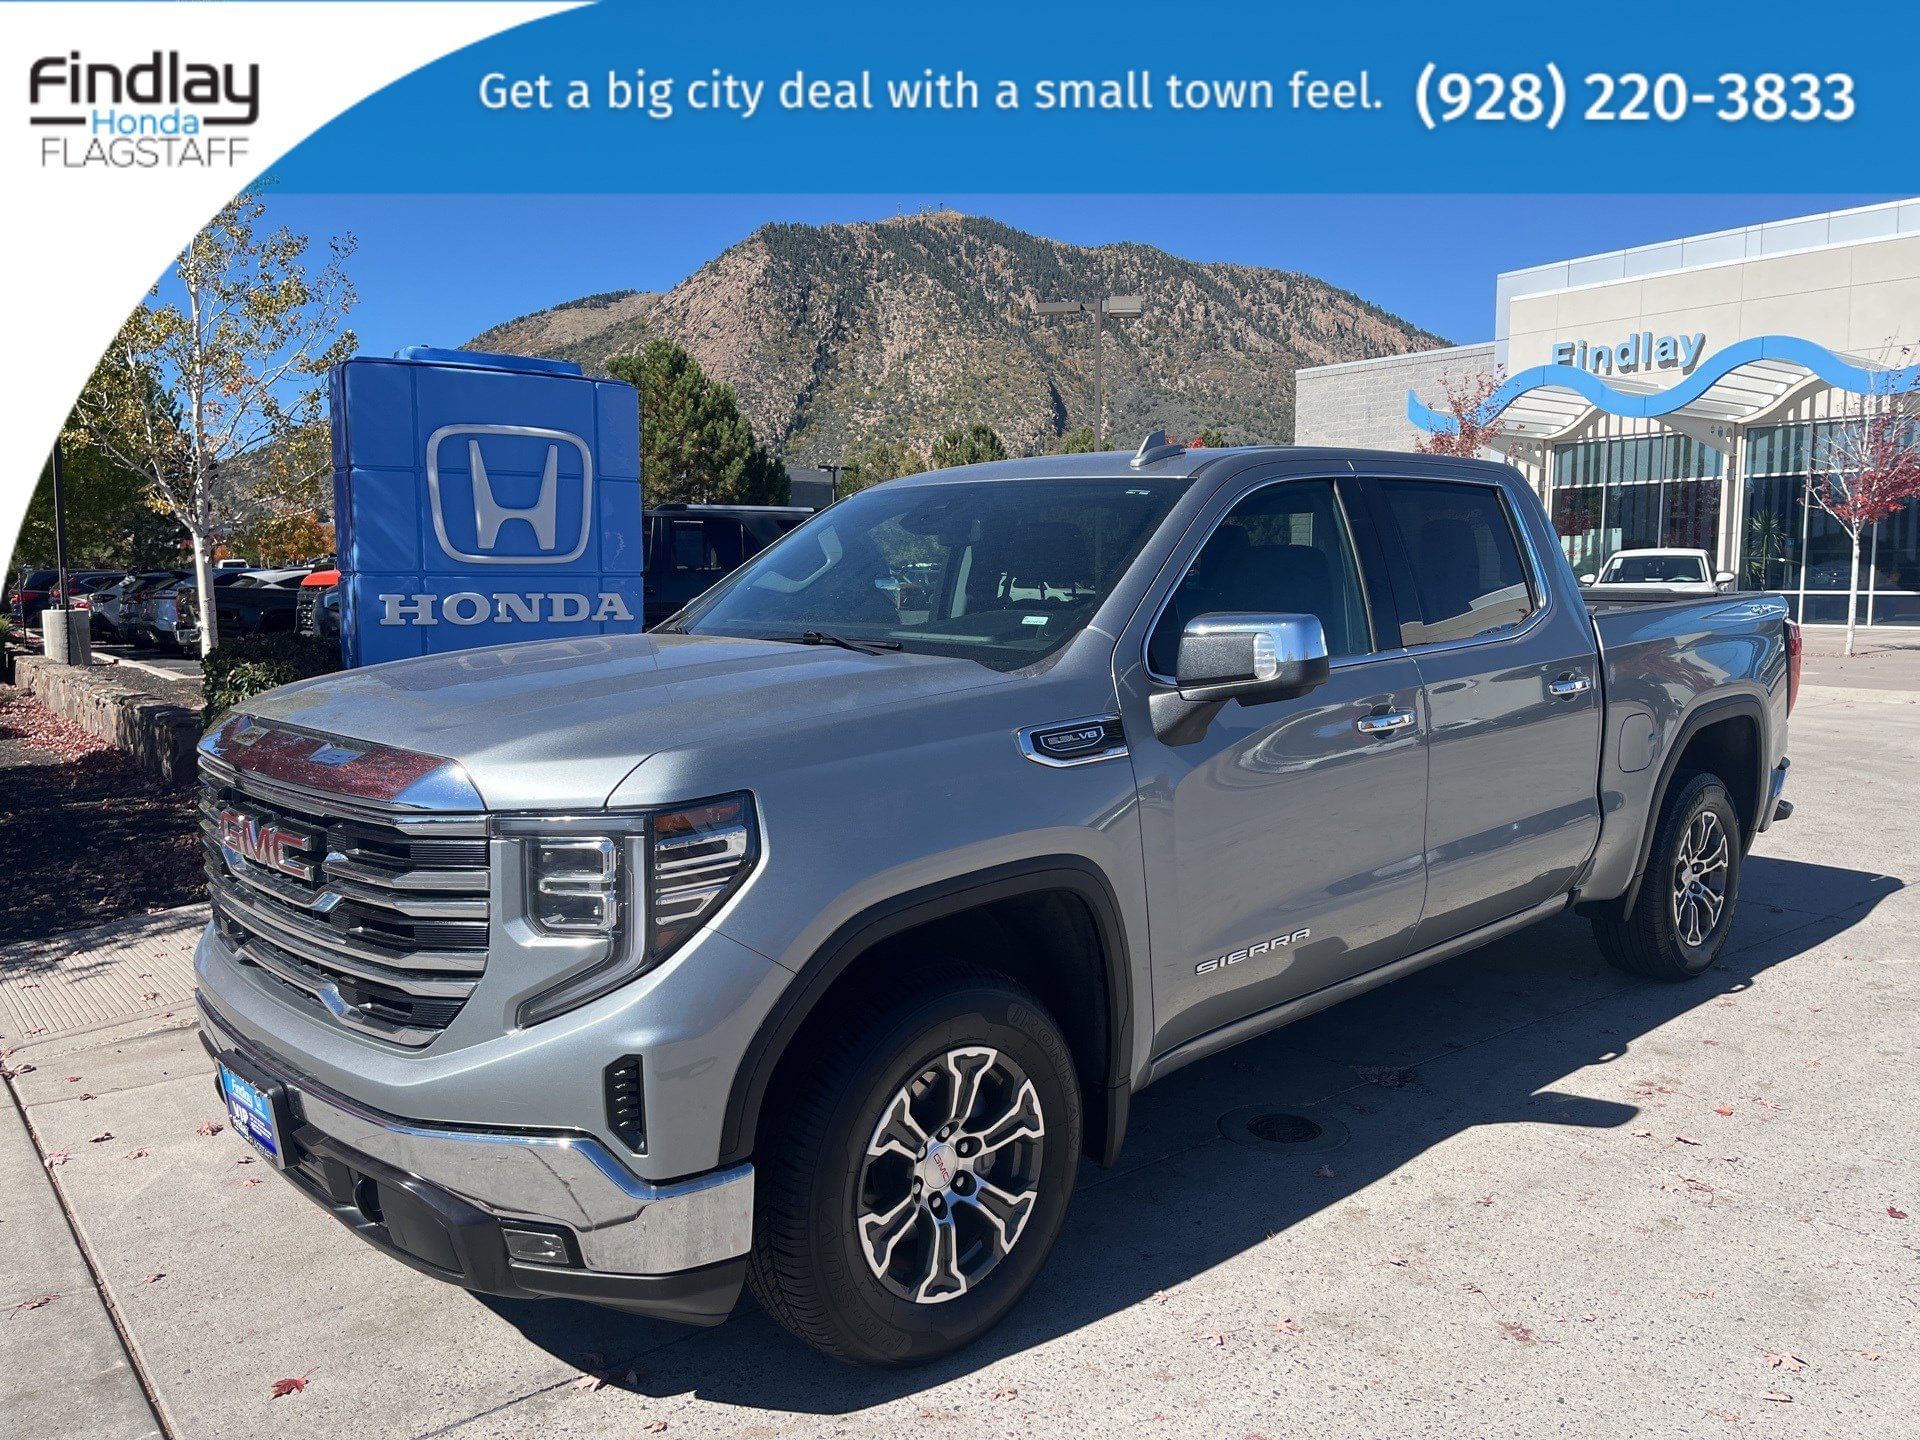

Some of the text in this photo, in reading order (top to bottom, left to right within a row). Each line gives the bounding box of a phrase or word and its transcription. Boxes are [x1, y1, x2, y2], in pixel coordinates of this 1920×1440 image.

[1551, 331, 1706, 376] Findlay
[378, 592, 635, 626] HONDA
[220, 810, 314, 881] GMC
[1195, 927, 1311, 976] SIERRA
[933, 1153, 950, 1182] GMC
